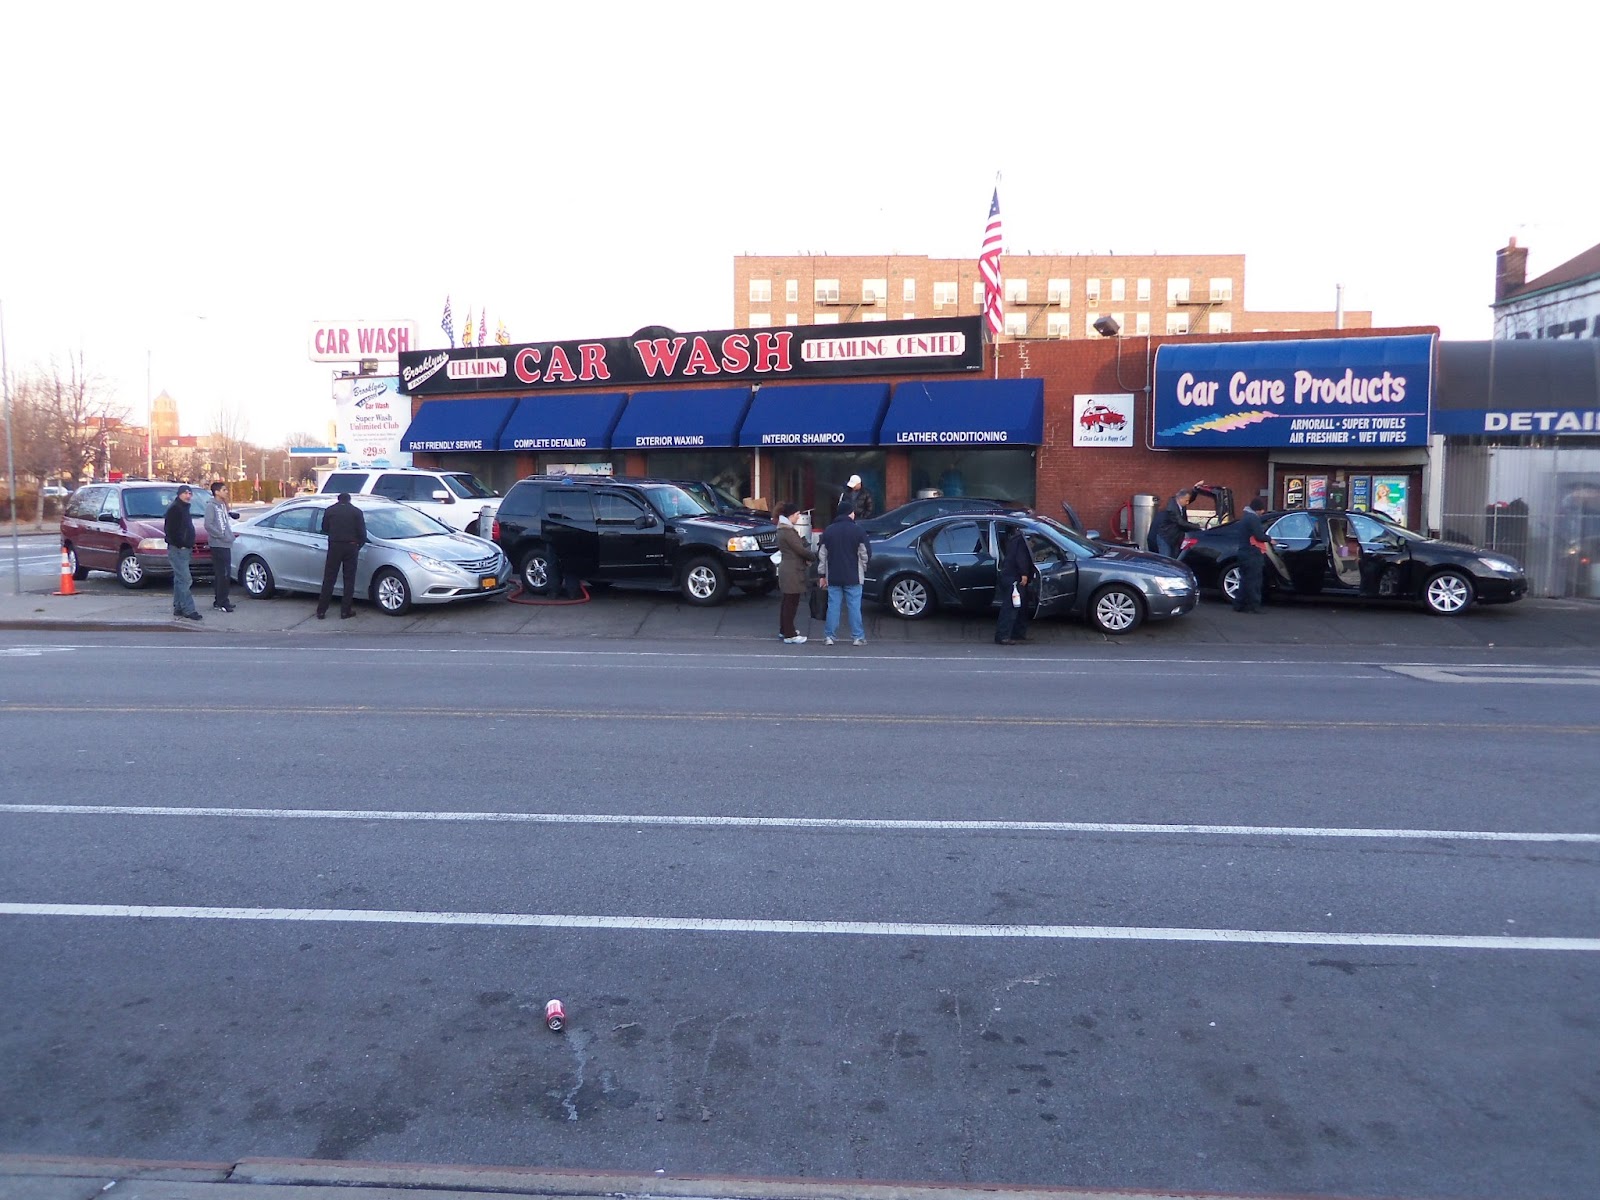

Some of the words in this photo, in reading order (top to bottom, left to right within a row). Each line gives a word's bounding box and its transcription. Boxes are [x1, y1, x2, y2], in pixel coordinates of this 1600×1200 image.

[315, 328, 350, 354] CAR
[357, 327, 409, 353] WASH
[806, 339, 888, 360] DETAILING
[896, 335, 961, 355] CENTER
[514, 343, 610, 383] CAR
[634, 331, 793, 376] WASH
[402, 351, 449, 382] Brooklyns
[451, 360, 503, 376] DETAILING
[410, 368, 436, 387] FAMOUS
[1176, 372, 1219, 406] Car
[1229, 371, 1285, 406] Care
[1294, 368, 1406, 405] Products
[365, 402, 374, 410] Car
[375, 402, 389, 410] Wash
[355, 415, 374, 423] Super
[1290, 418, 1335, 430] ARMORALL
[1342, 418, 1370, 430] SUPER
[1372, 417, 1406, 429] TOWELS
[1484, 411, 1600, 431] DETAI
[383, 422, 399, 430] Club
[636, 436, 672, 446] EXTERIOR
[674, 435, 704, 445] WAXING
[762, 434, 800, 444] INTERIOR
[802, 433, 845, 443] SHAMPOO
[897, 432, 938, 442] LEATHER
[939, 431, 1007, 442] CONDITIONING
[1289, 432, 1305, 443] AIR
[1306, 432, 1348, 443] FRESHNER
[1359, 431, 1378, 442] WET
[1380, 431, 1406, 442] WIPES
[410, 441, 425, 450] FAST
[426, 441, 455, 450] FRIENDLY
[455, 440, 482, 449] SERVICE
[514, 439, 550, 448] COMPLETE
[550, 438, 586, 448] DETAILING
[363, 446, 386, 456] $29.95
